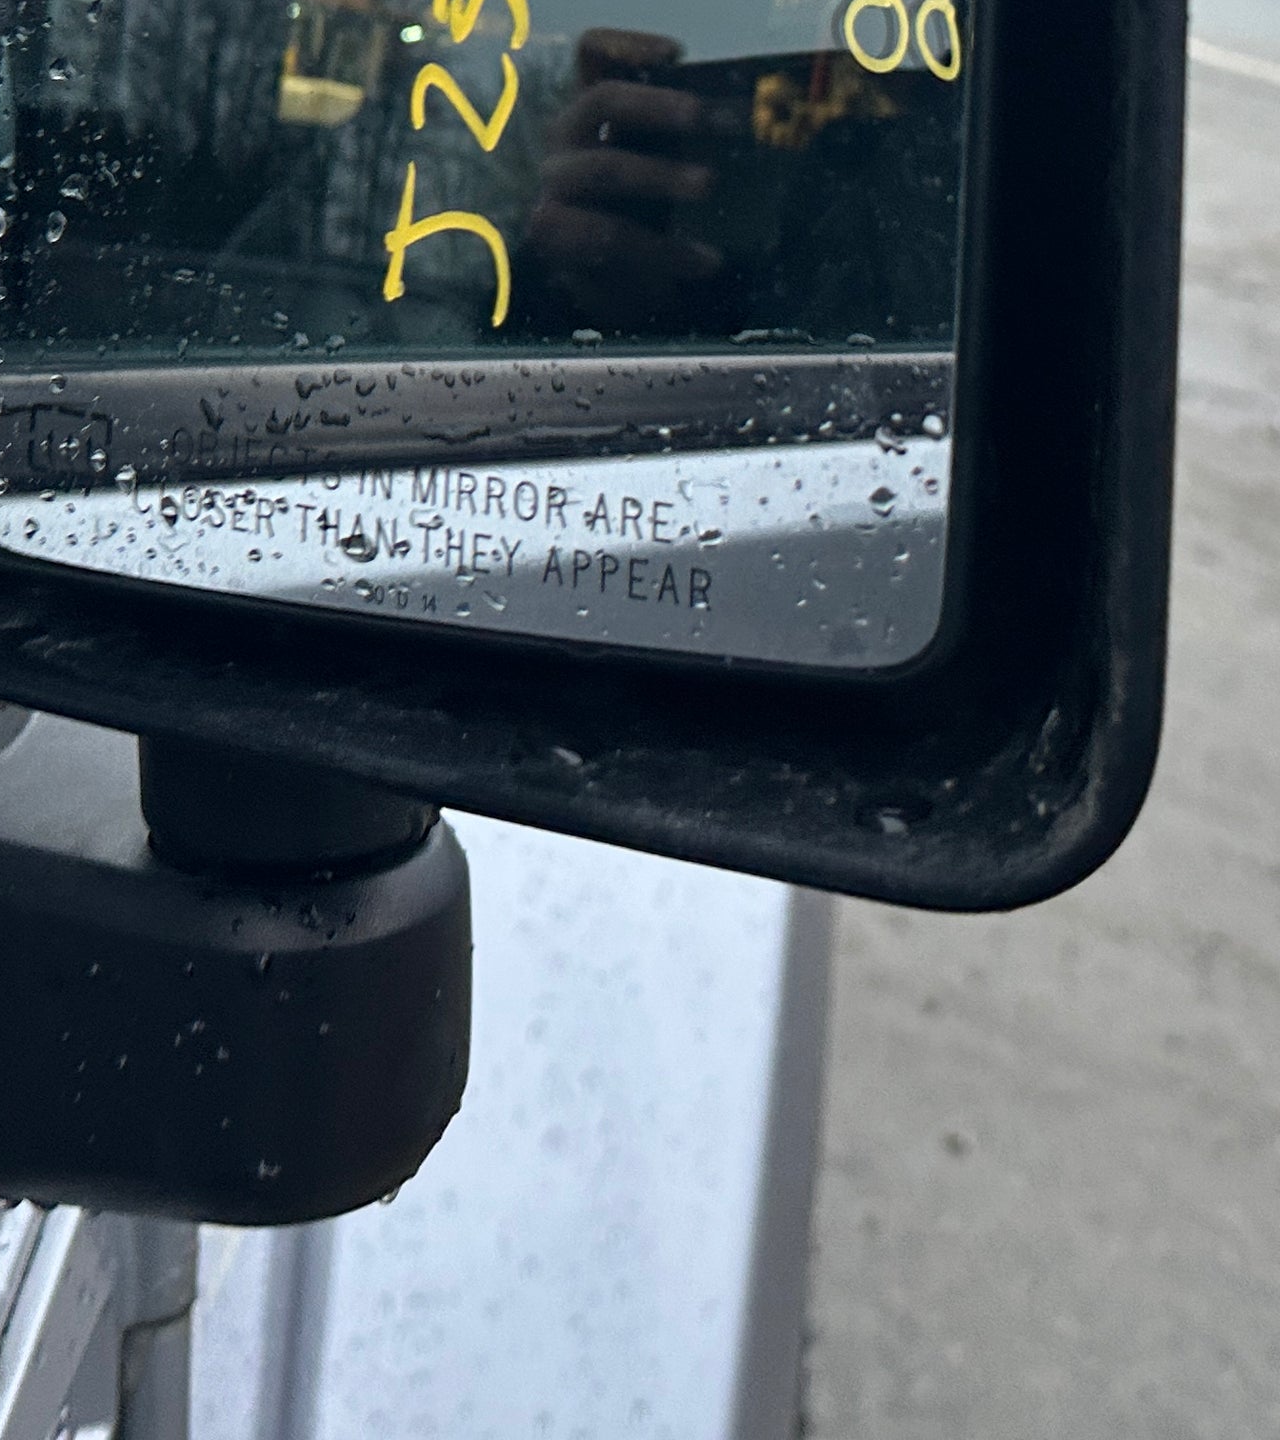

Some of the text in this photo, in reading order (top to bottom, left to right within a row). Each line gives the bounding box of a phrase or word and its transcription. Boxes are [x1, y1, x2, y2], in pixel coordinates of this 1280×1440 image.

[357, 459, 393, 501] IN
[409, 466, 568, 529] MIRROR
[589, 491, 676, 545] ARE
[416, 523, 523, 577] THEY
[542, 545, 714, 612] APPEAR
